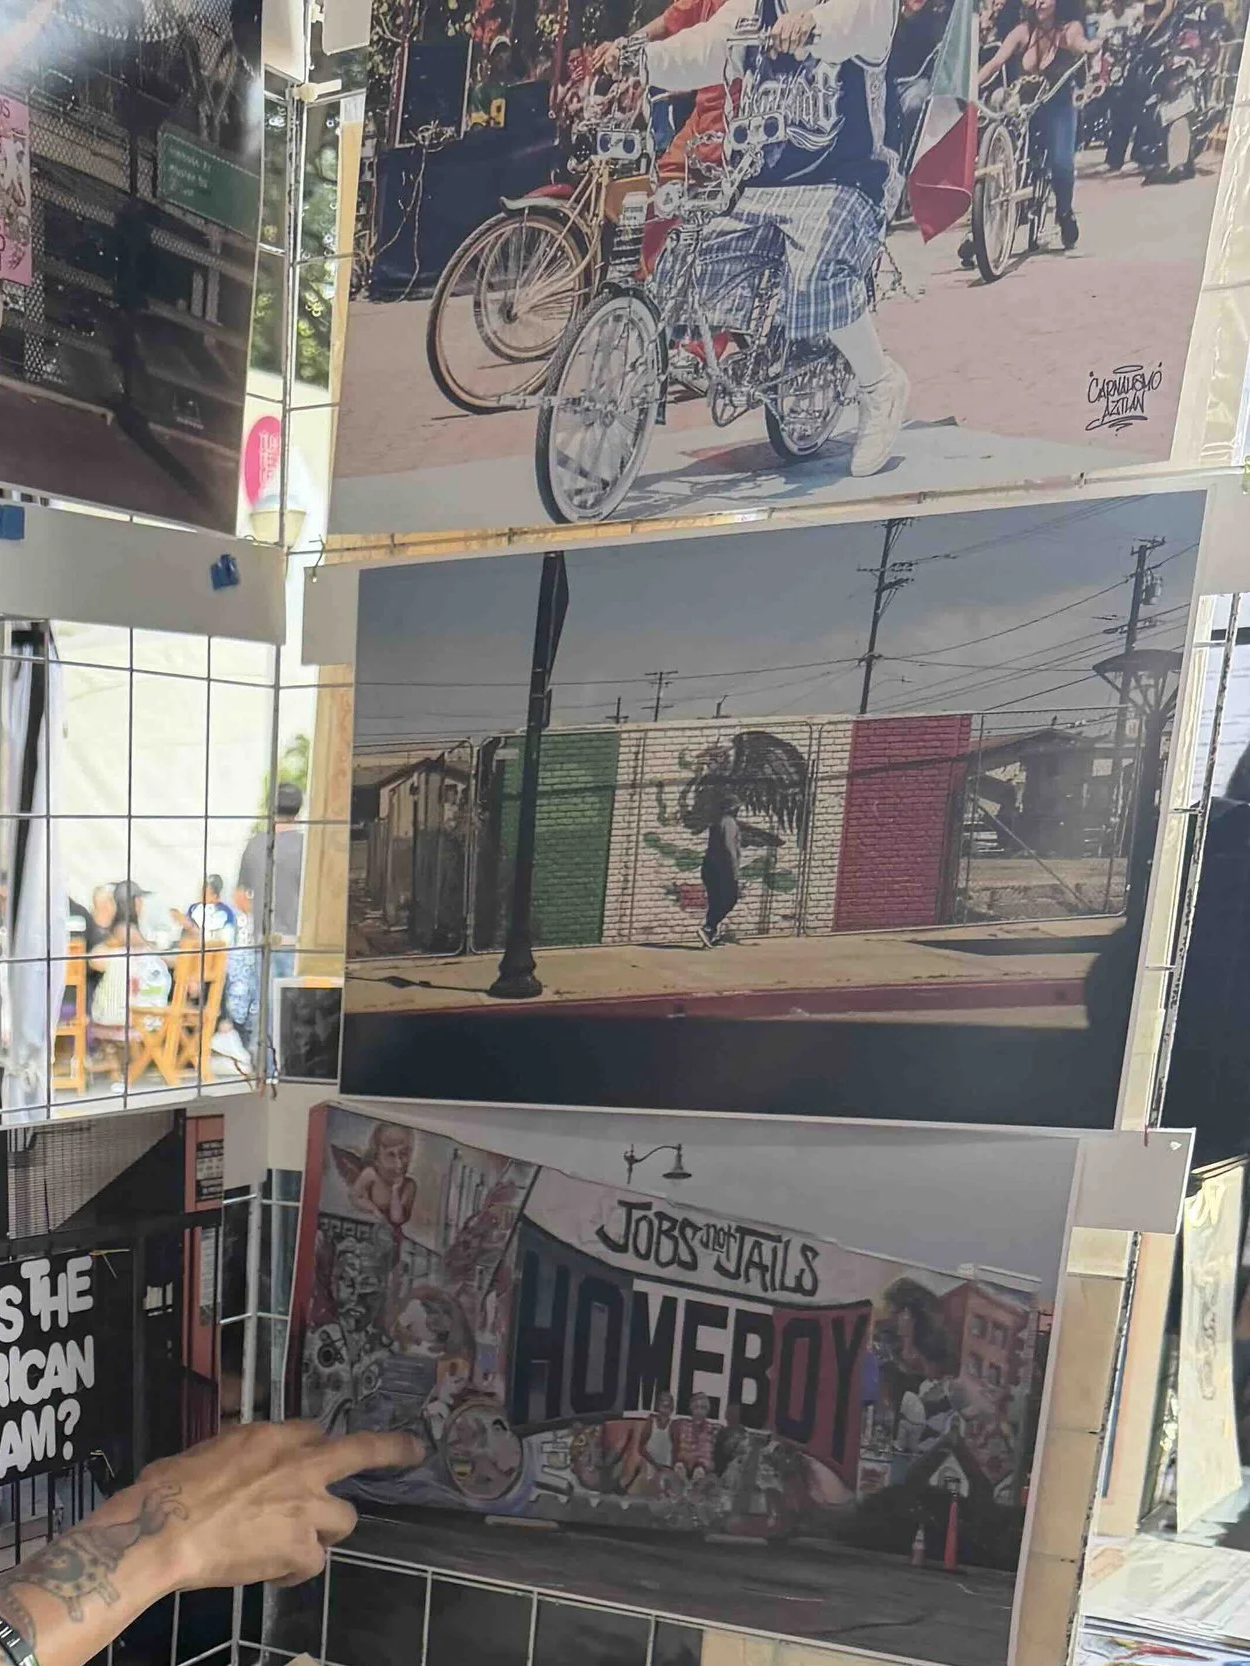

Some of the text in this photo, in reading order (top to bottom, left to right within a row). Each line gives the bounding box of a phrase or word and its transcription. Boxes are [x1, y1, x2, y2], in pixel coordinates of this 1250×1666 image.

[21, 1256, 95, 1333] THE
[596, 1199, 820, 1298] JOBS not JAILS
[513, 1248, 870, 1466] HOMEBOY
